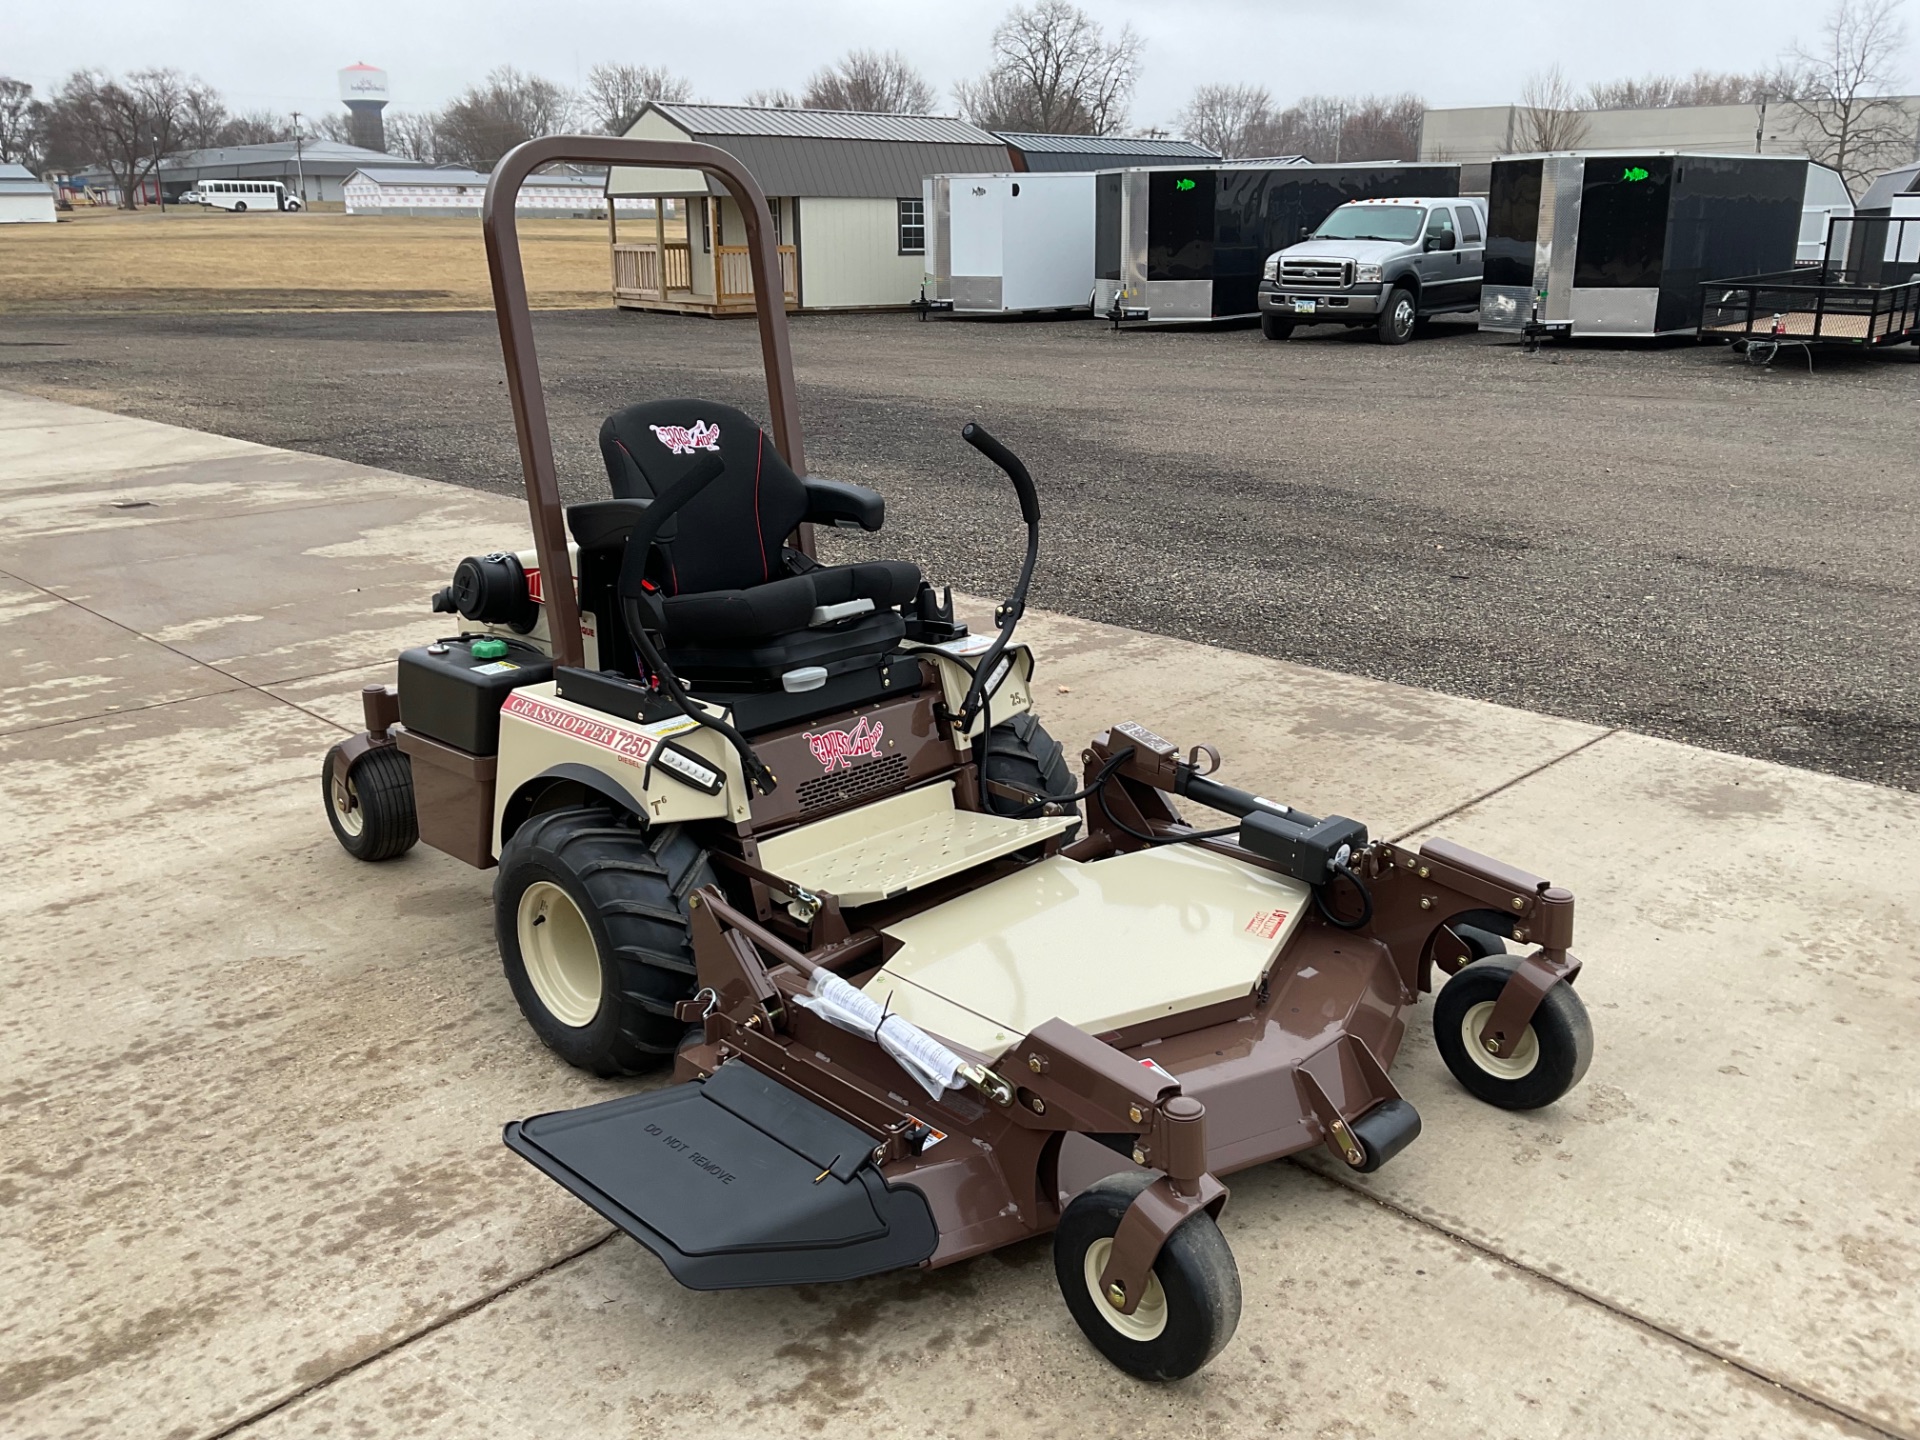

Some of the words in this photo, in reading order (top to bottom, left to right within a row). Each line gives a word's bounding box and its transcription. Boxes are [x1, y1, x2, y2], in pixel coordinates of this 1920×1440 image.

[1010, 692, 1021, 707] 25
[510, 698, 614, 744] GRASSHOPPER
[614, 731, 652, 758] 725D
[805, 718, 883, 770] GRASSHOPPER
[617, 755, 641, 769] DIESEL
[1272, 909, 1289, 918] 61
[643, 1123, 663, 1136] DO
[662, 1135, 690, 1152] NOT
[688, 1152, 737, 1185] REMOVE
